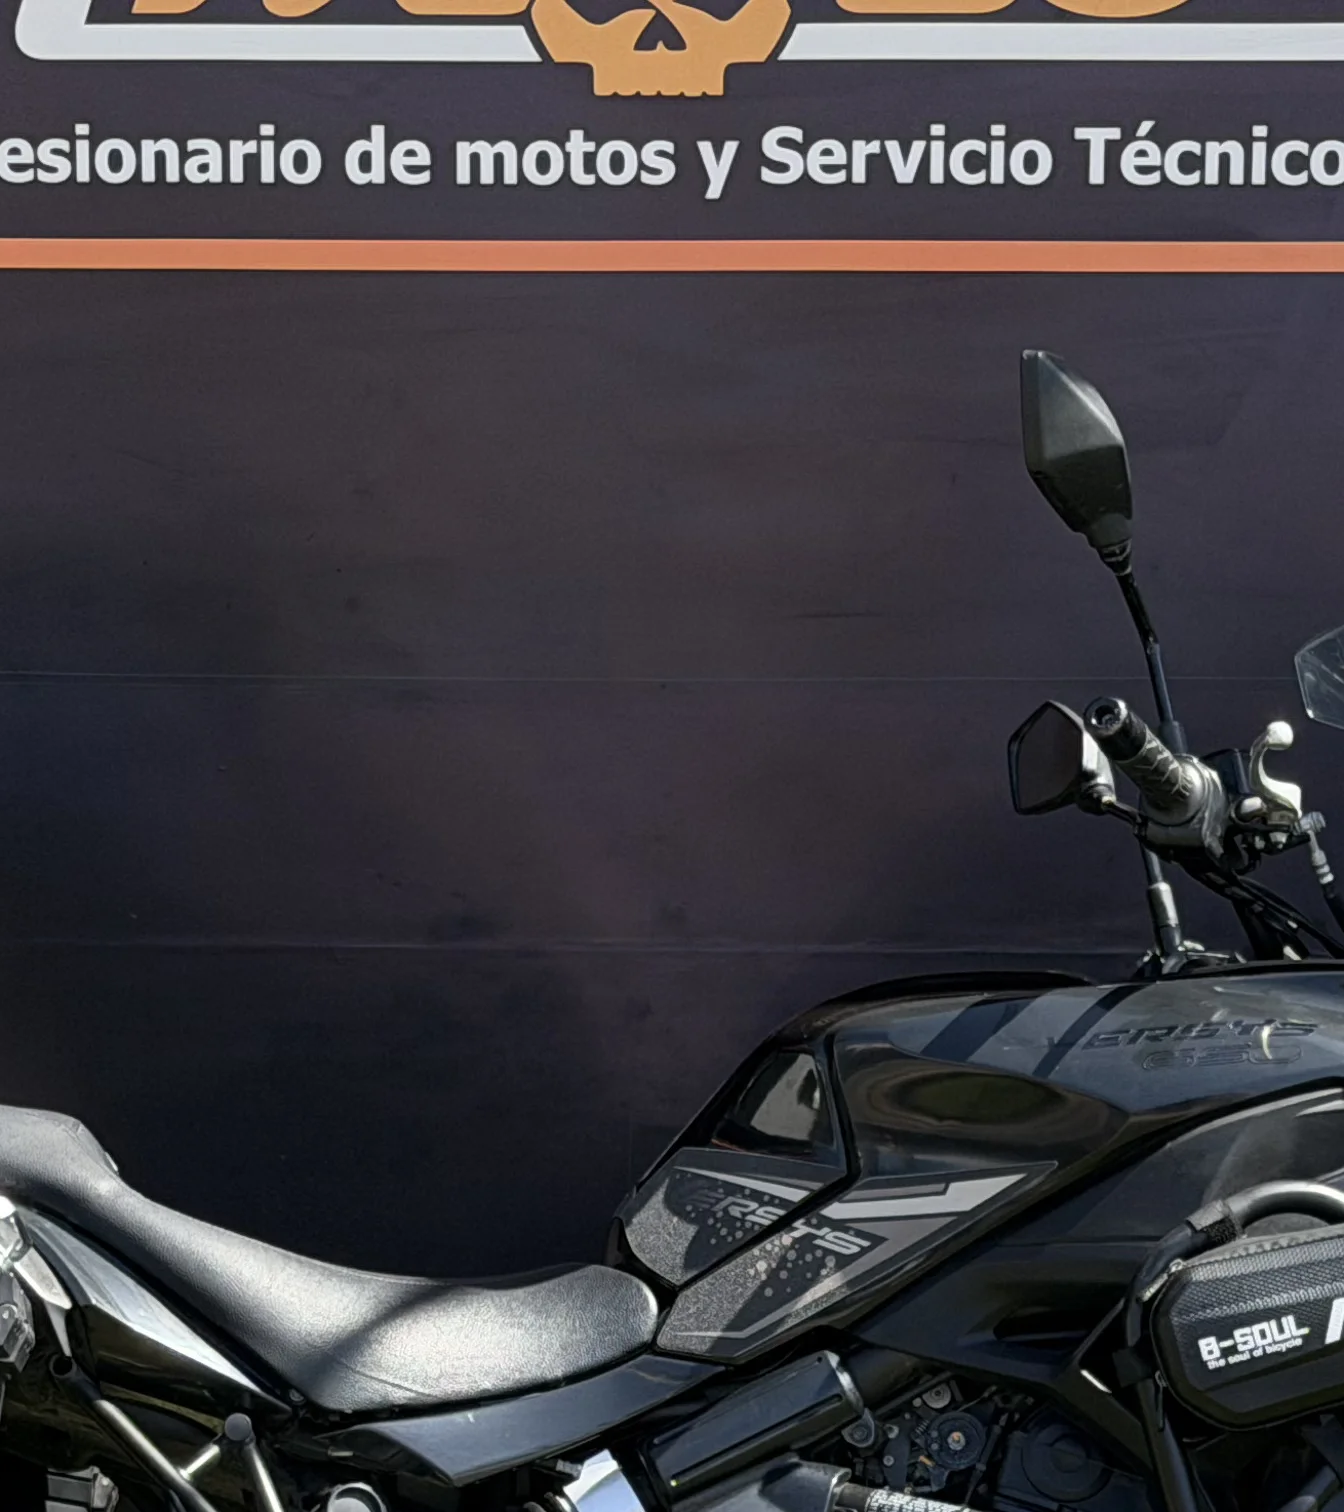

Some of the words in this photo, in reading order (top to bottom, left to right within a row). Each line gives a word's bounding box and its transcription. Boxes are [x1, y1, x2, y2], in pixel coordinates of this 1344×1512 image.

[345, 125, 431, 184] de
[457, 130, 675, 185] motos
[697, 141, 739, 199] y
[761, 124, 1052, 185] Servicio
[1206, 1357, 1226, 1371] the
[1227, 1350, 1252, 1365] soul
